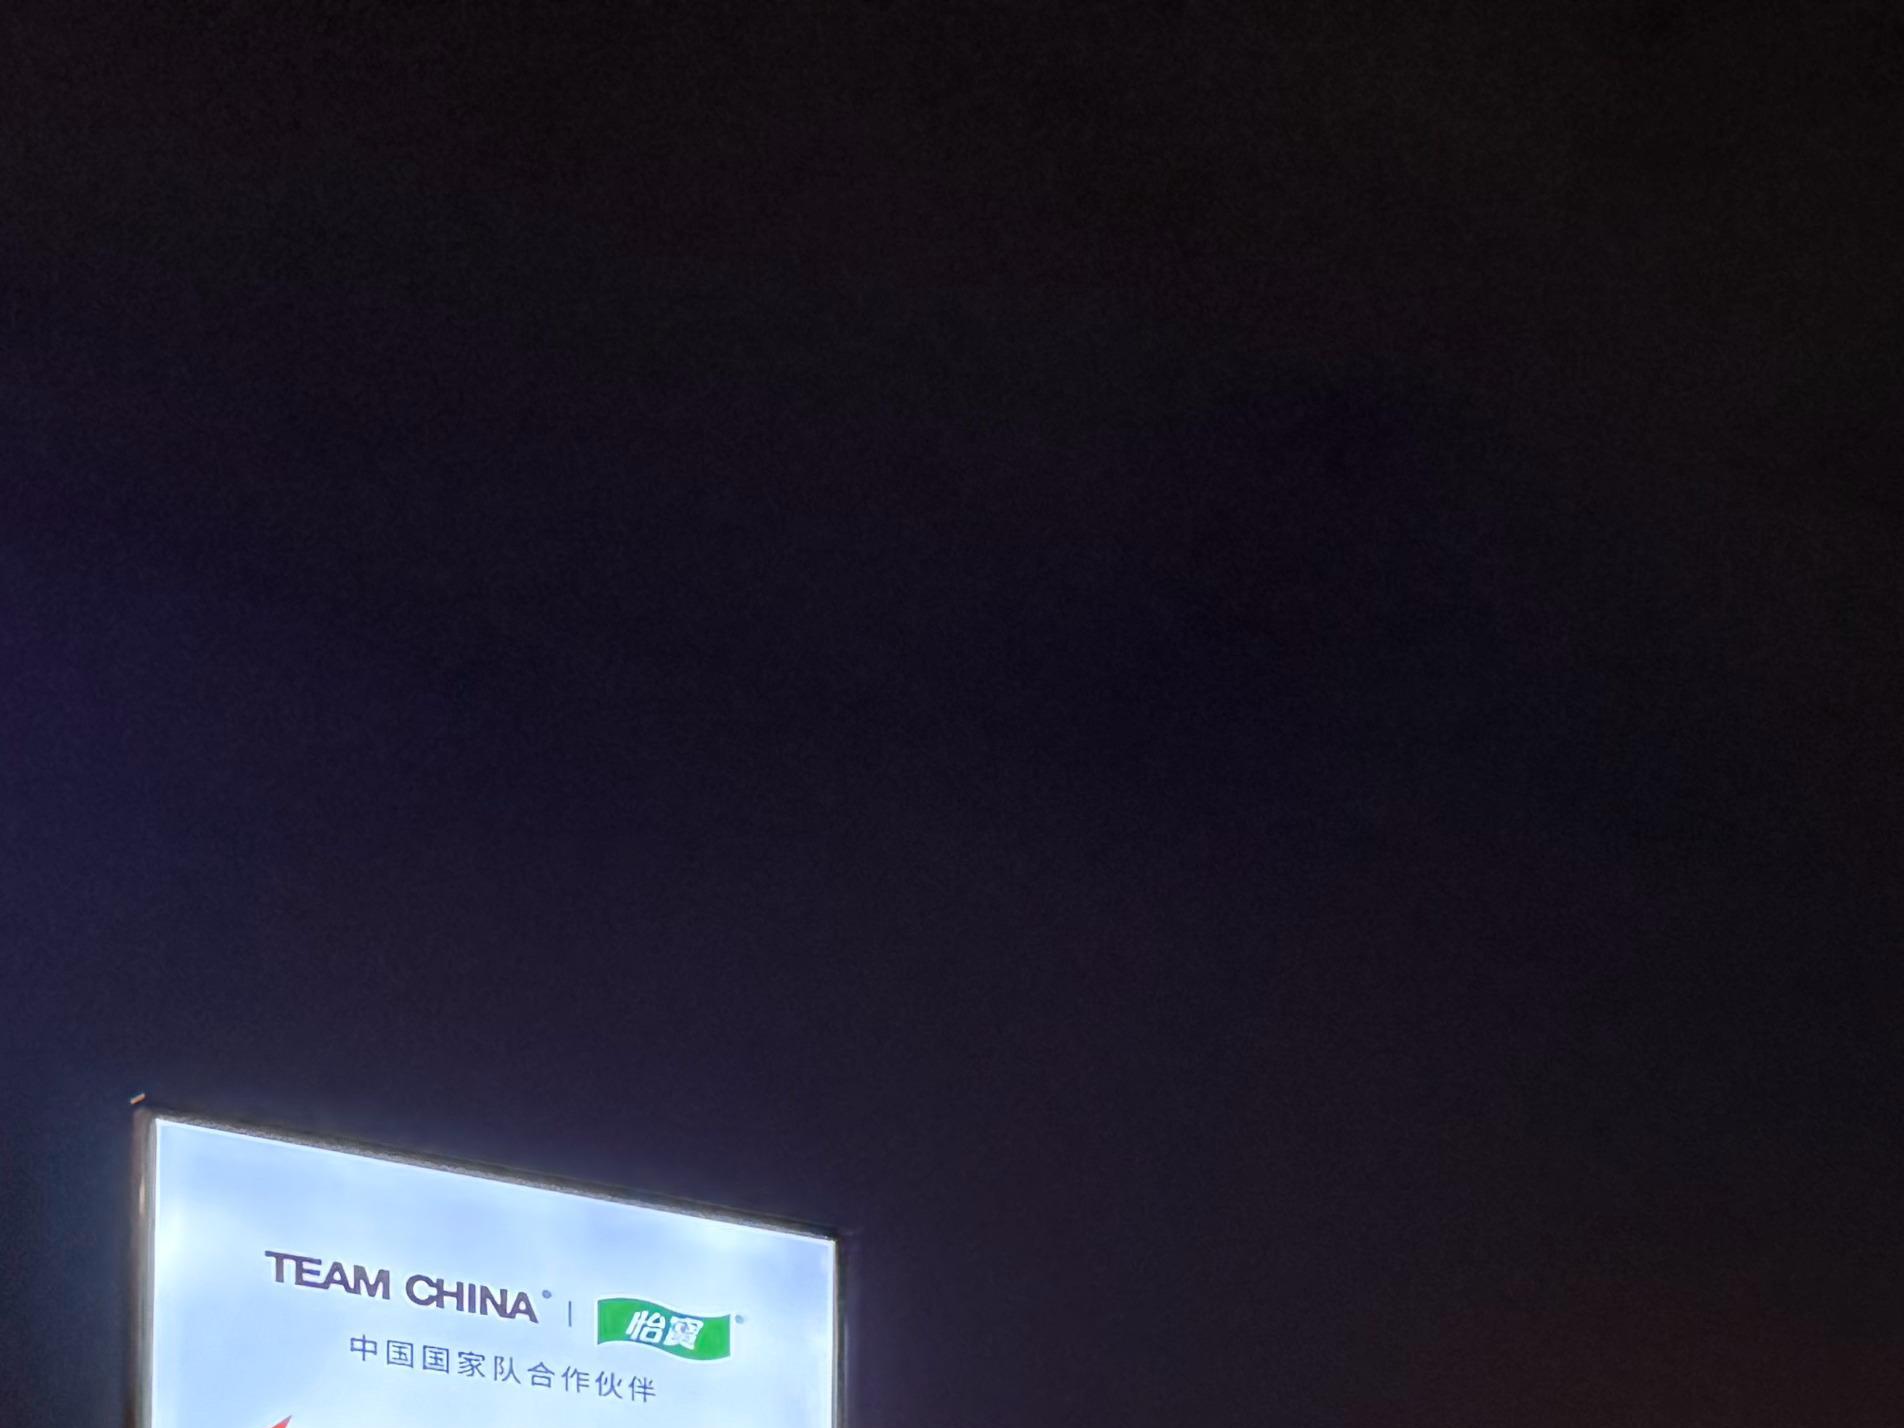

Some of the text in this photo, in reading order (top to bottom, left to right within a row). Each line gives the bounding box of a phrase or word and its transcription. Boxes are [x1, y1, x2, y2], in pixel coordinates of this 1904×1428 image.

[264, 1250, 539, 1324] TEAM CHINA
[348, 1334, 657, 1404] 中国国家队合作伙伴
